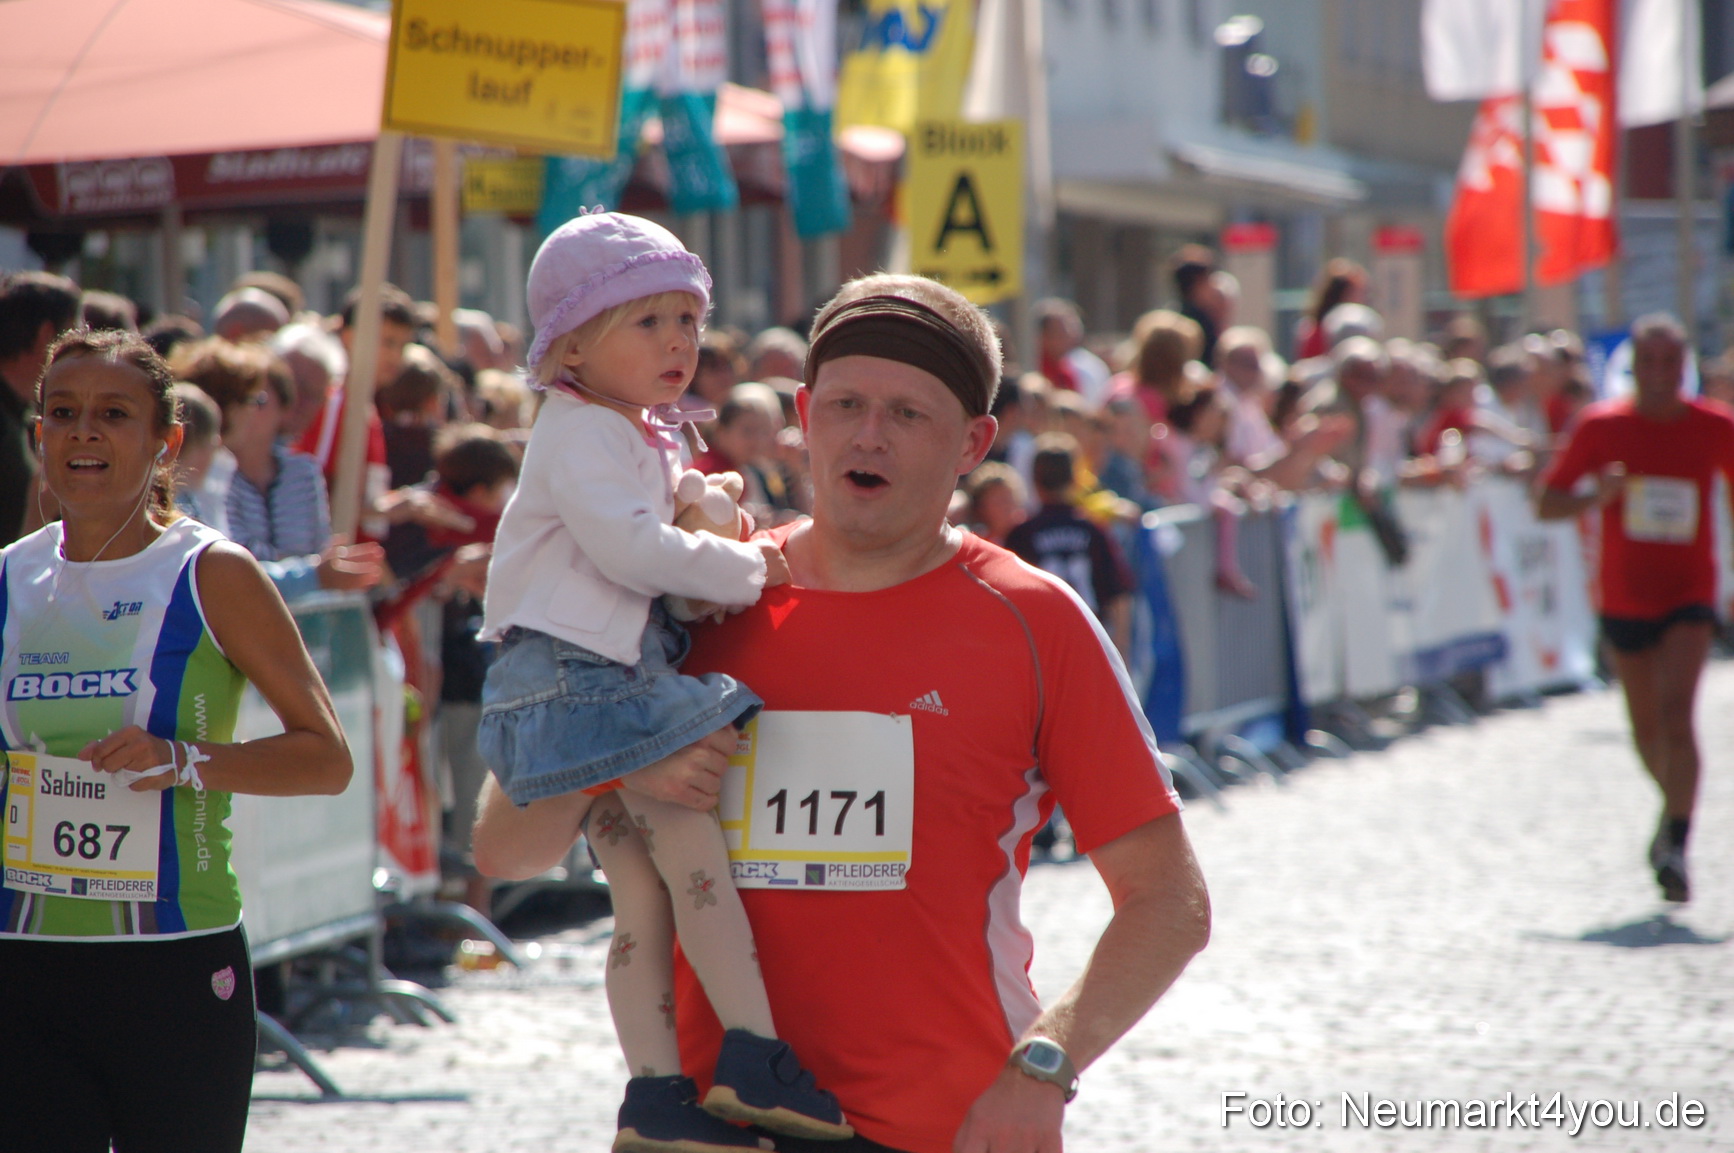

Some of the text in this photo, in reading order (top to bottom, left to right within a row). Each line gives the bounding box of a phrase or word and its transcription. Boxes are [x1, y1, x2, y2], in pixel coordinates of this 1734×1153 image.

[405, 18, 606, 70] Schnupper-
[467, 69, 534, 105] lauf
[935, 173, 992, 252] A
[19, 652, 70, 665] TEAM
[6, 668, 138, 701] BOCK
[909, 701, 949, 717] adidas
[40, 768, 106, 800] Sabine
[766, 788, 886, 837] 1171
[53, 820, 131, 861] 687
[5, 868, 52, 888] BOCK
[88, 878, 154, 892] PFLEIDERER
[729, 862, 779, 879] OCK
[828, 863, 907, 878] PFLEIDERER
